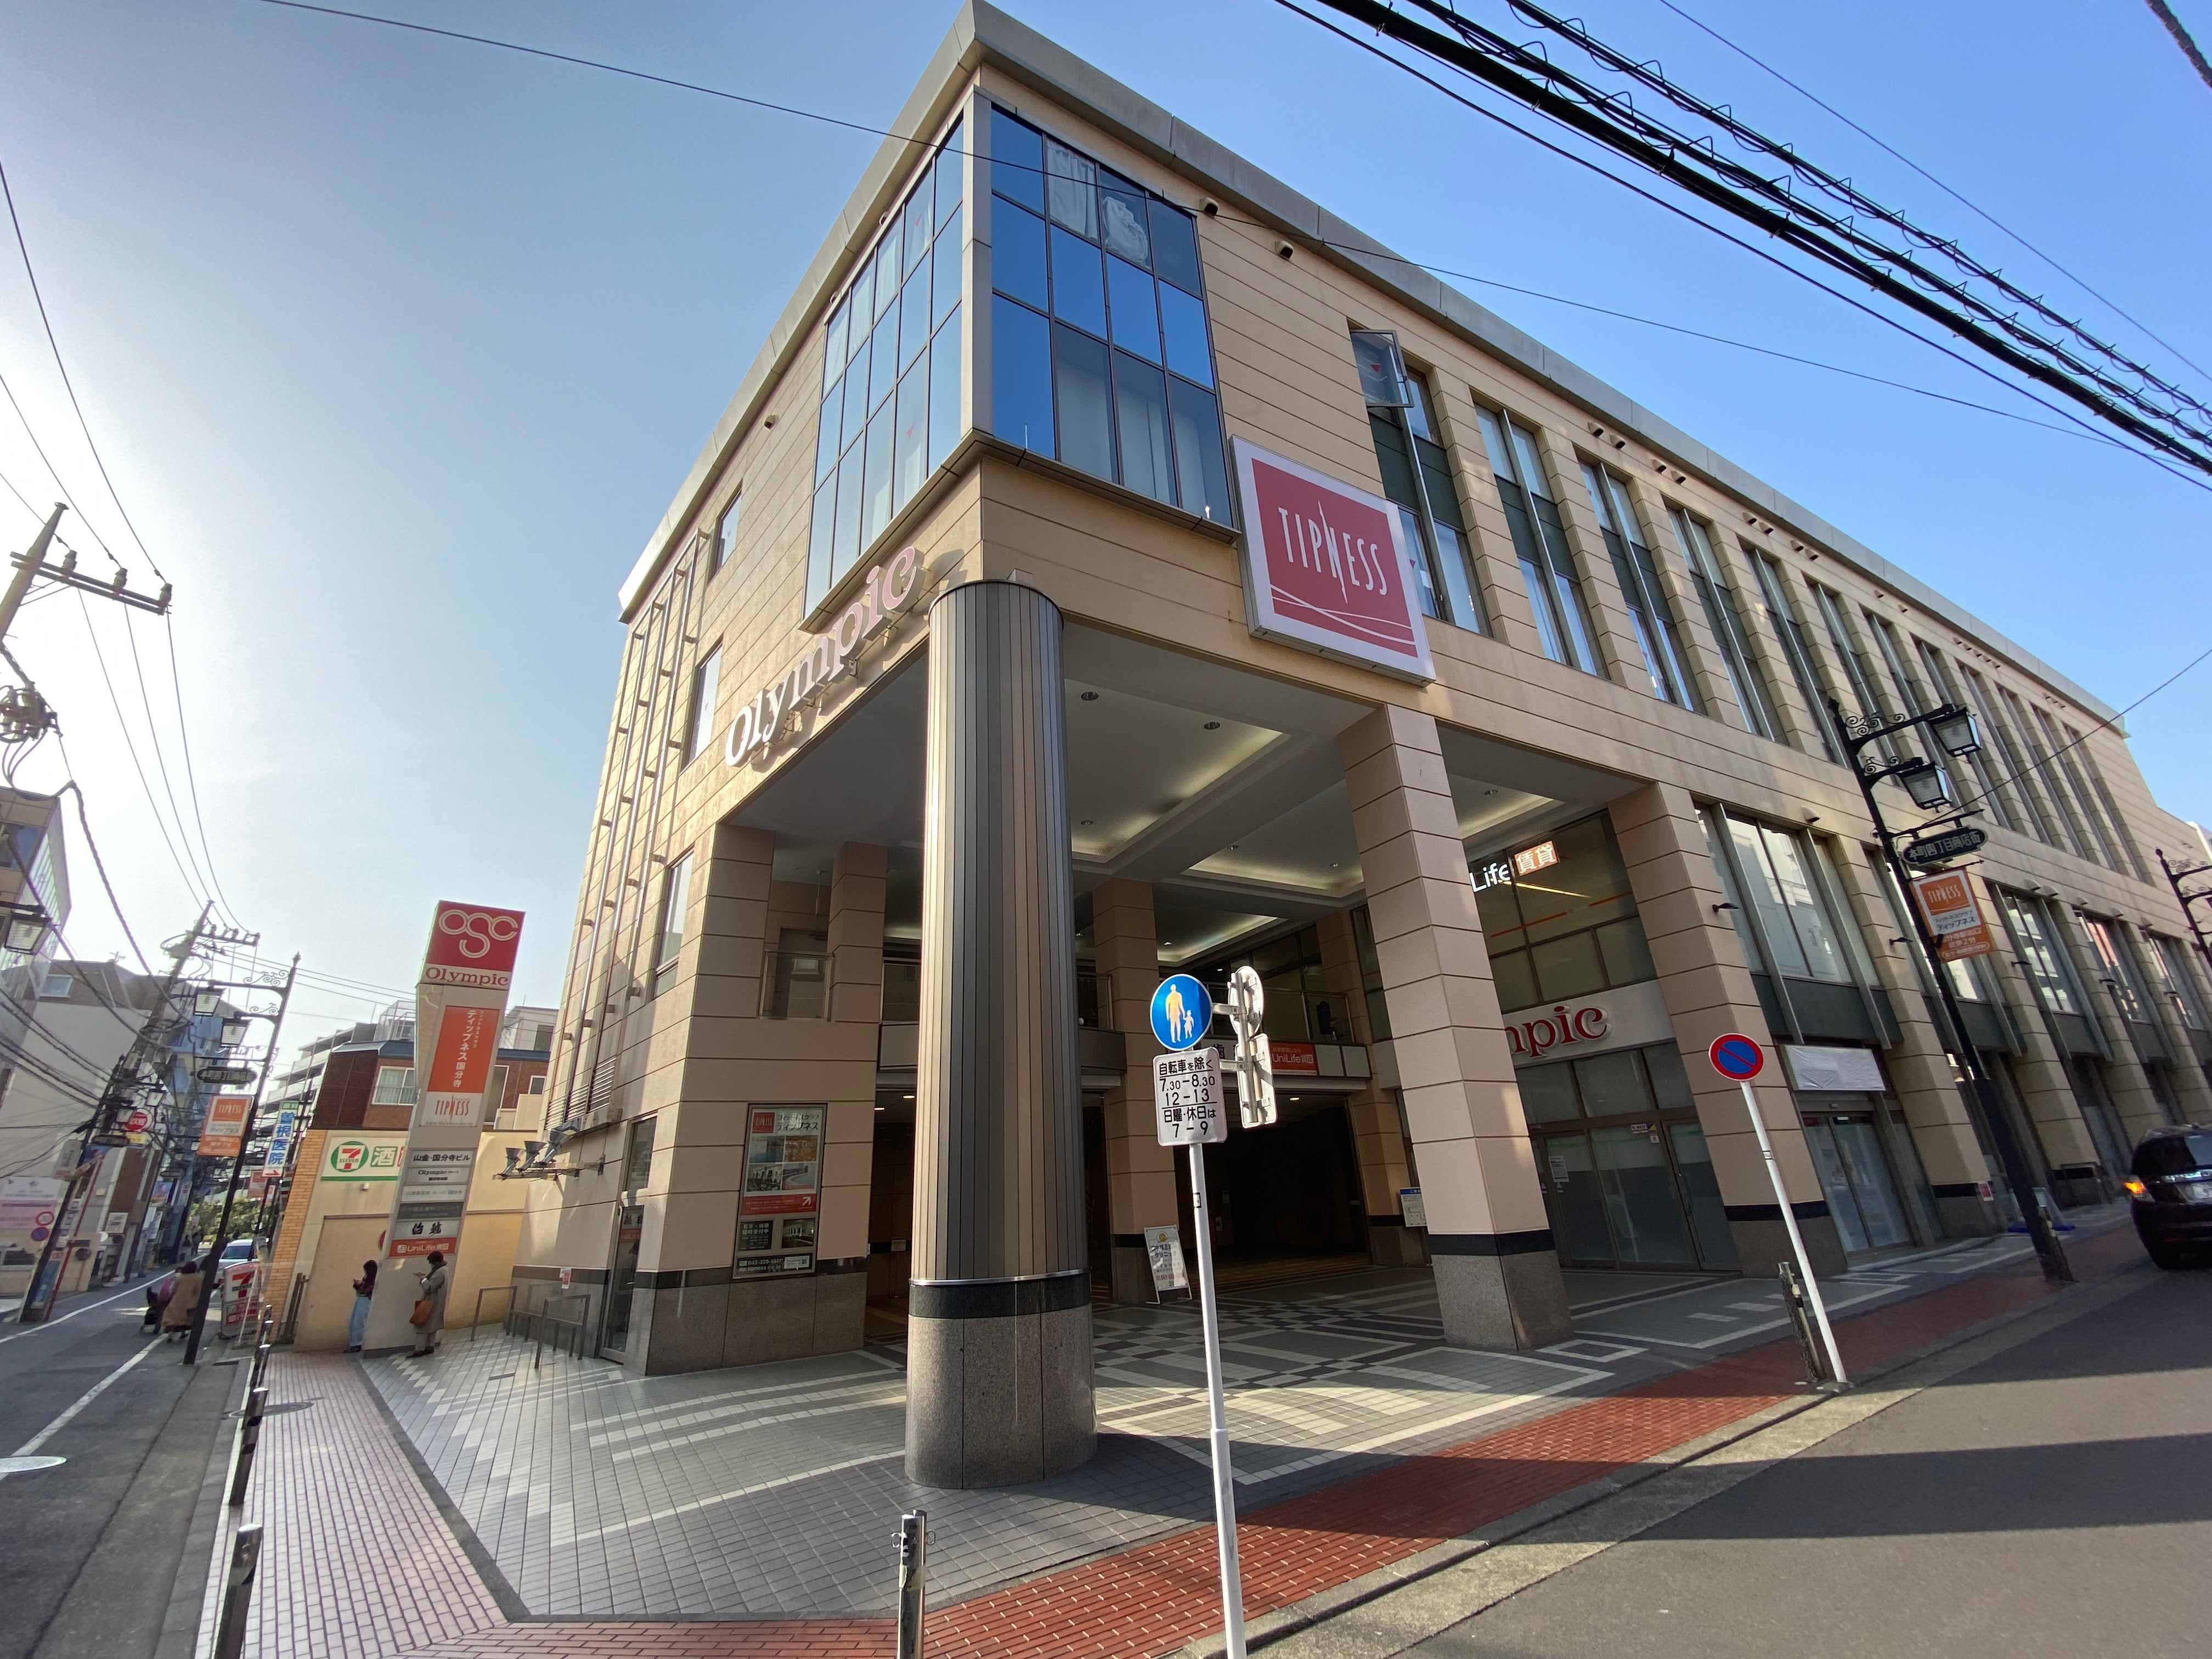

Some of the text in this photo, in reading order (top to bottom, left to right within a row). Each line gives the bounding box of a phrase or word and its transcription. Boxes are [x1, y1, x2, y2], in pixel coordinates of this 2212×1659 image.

[1278, 500, 1387, 604] TIPNESS
[725, 546, 922, 766] Olympic
[1469, 844, 1558, 893] Life 賃貸
[1927, 884, 1961, 905] TIPNESS
[425, 967, 509, 986] Olympic
[1159, 1057, 1214, 1075] 自転車を除く
[1272, 1053, 1301, 1063] UniLife
[435, 1095, 470, 1121] TIPNESS
[1164, 1105, 1217, 1123] 日曜・休日は
[342, 1148, 362, 1169] 7
[371, 1147, 398, 1166] 酒
